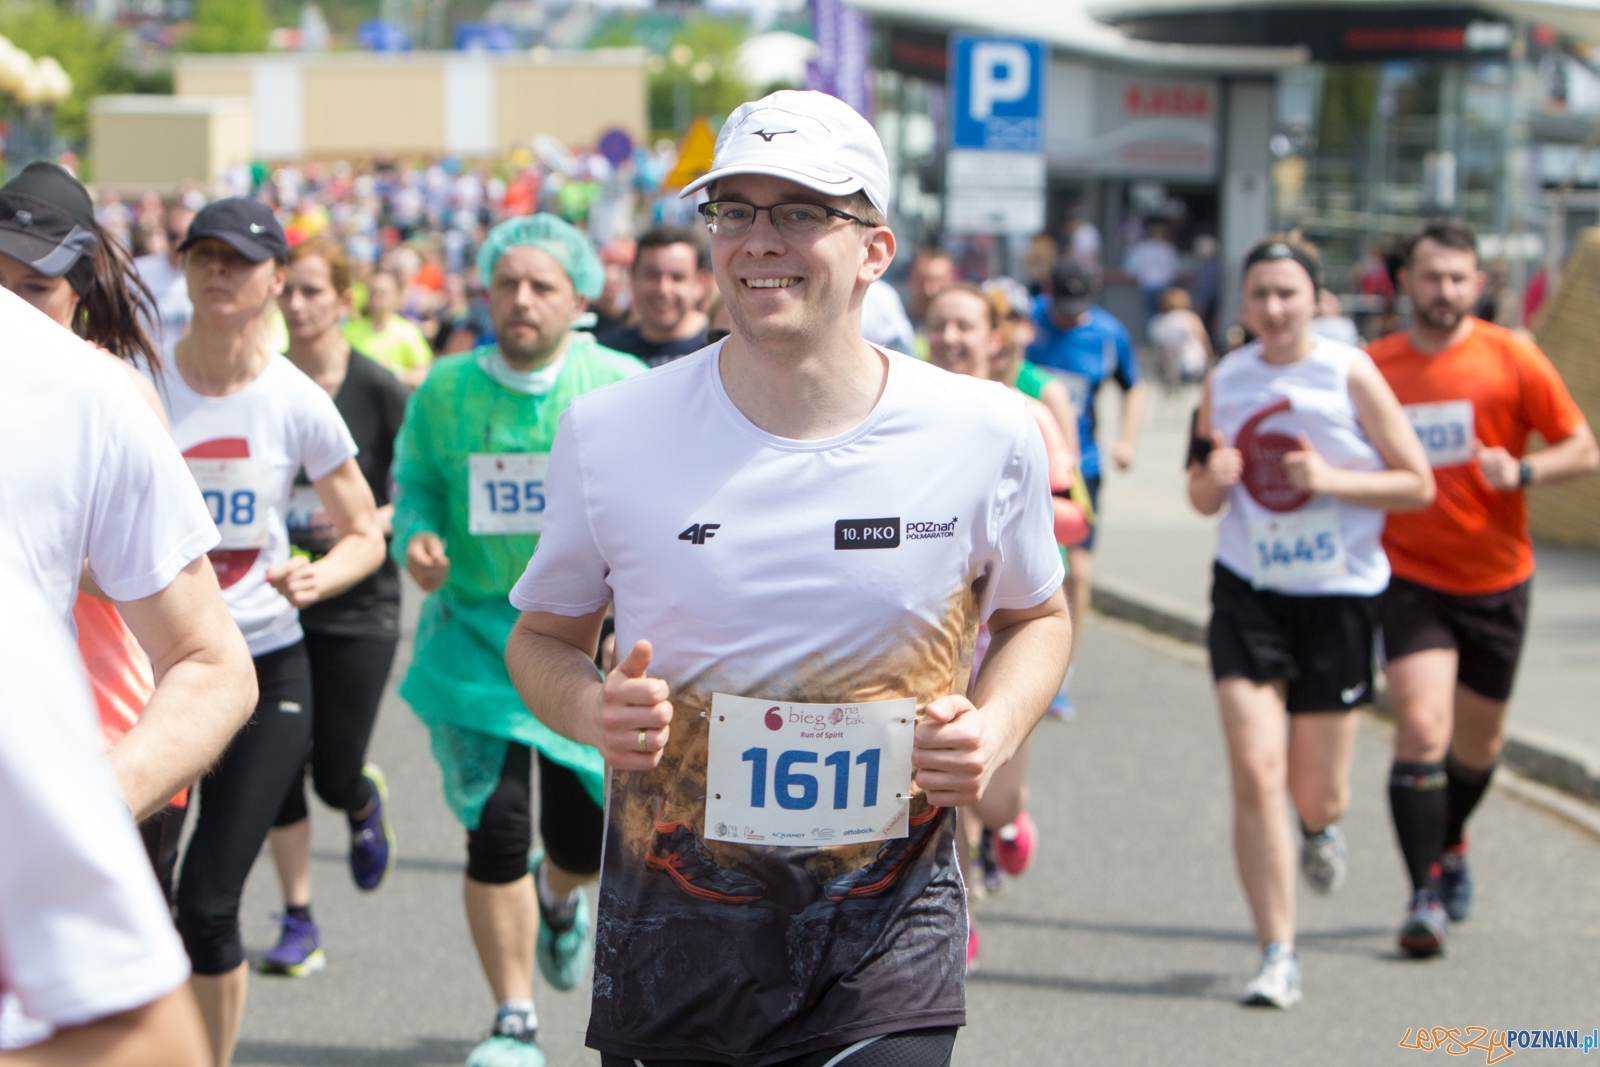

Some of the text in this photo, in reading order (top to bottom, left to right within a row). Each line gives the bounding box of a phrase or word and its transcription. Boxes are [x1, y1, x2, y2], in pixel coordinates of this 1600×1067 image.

[484, 480, 546, 514] 135
[678, 523, 721, 545] 4F
[841, 526, 895, 540] 10. PKO
[1257, 531, 1337, 569] 1445
[788, 706, 827, 731] bieg
[844, 706, 859, 715] na
[845, 714, 865, 726] tak
[824, 731, 844, 740] Spirit
[741, 747, 881, 810] 1611
